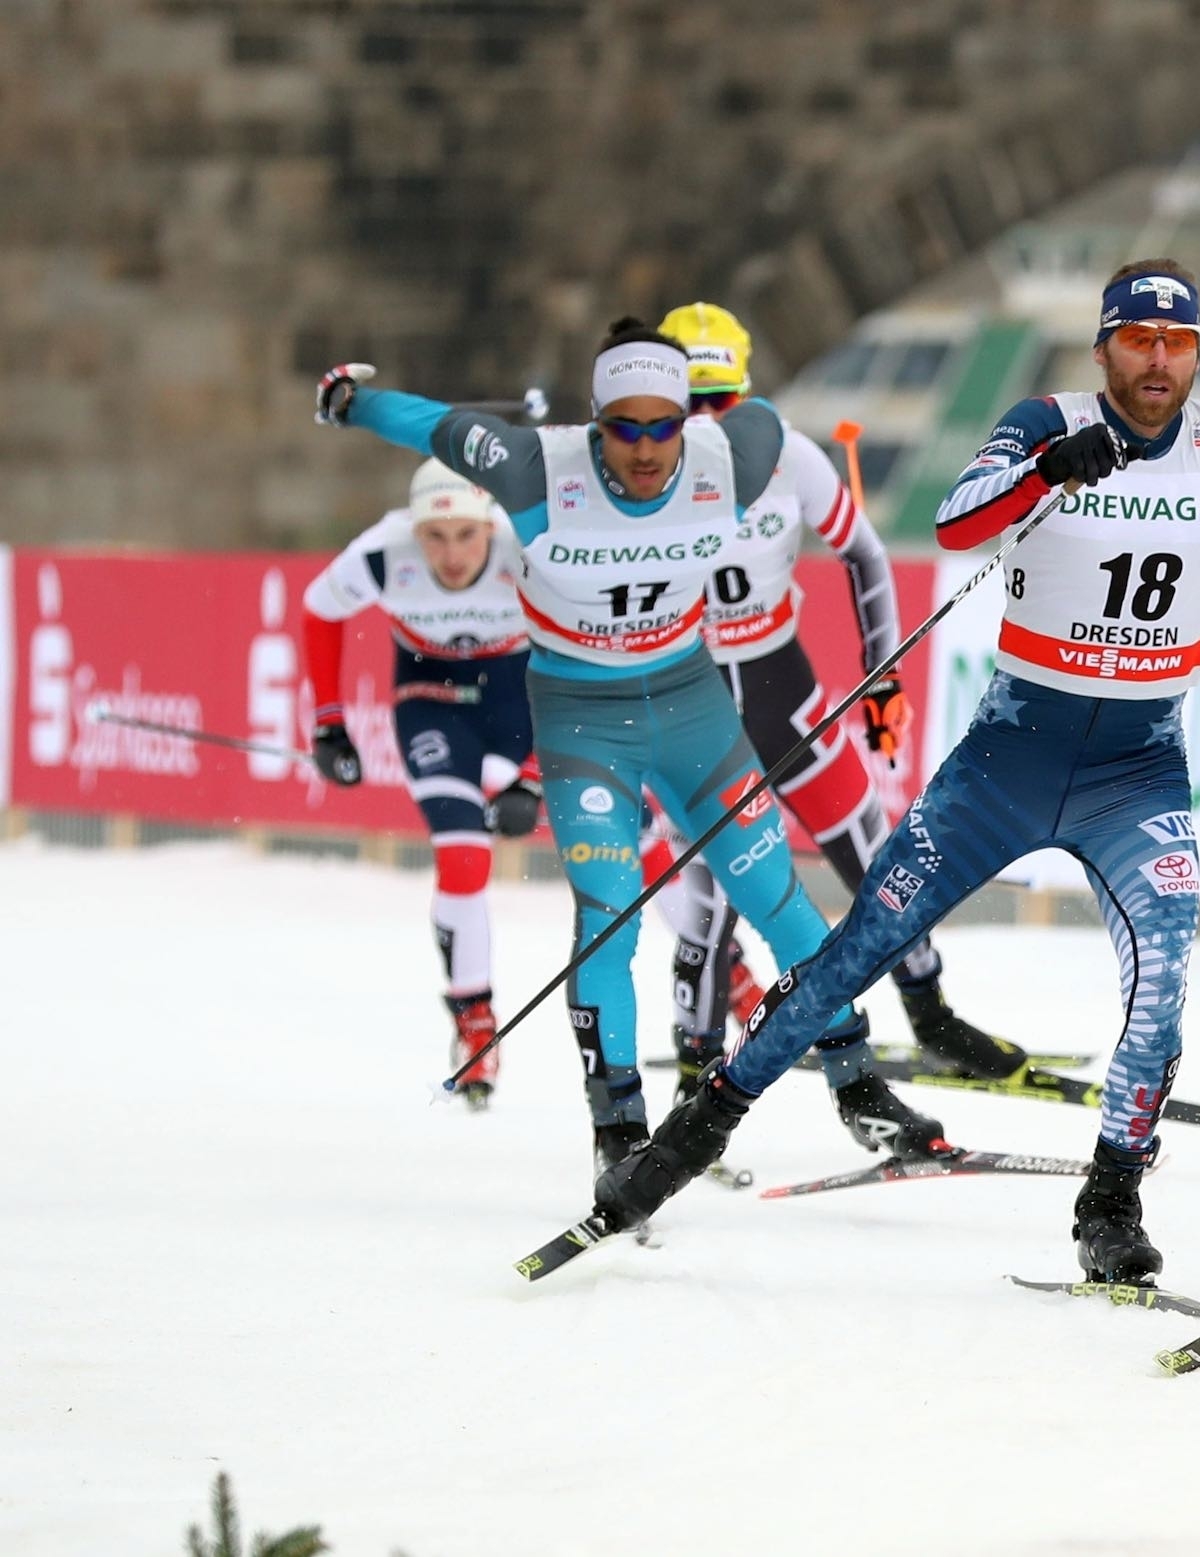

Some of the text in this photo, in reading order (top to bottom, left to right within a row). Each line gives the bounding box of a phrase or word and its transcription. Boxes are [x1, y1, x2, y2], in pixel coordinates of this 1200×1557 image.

[1059, 492, 1197, 521] DREWAG
[548, 543, 686, 566] DREWAG
[598, 580, 671, 618] 17
[704, 566, 751, 604] 0
[1099, 552, 1184, 622] 18
[577, 608, 681, 637] DRESDEN
[1070, 622, 1179, 647] DRESDEN
[1058, 647, 1182, 677] VIESSMANN
[909, 788, 936, 853] RAFT
